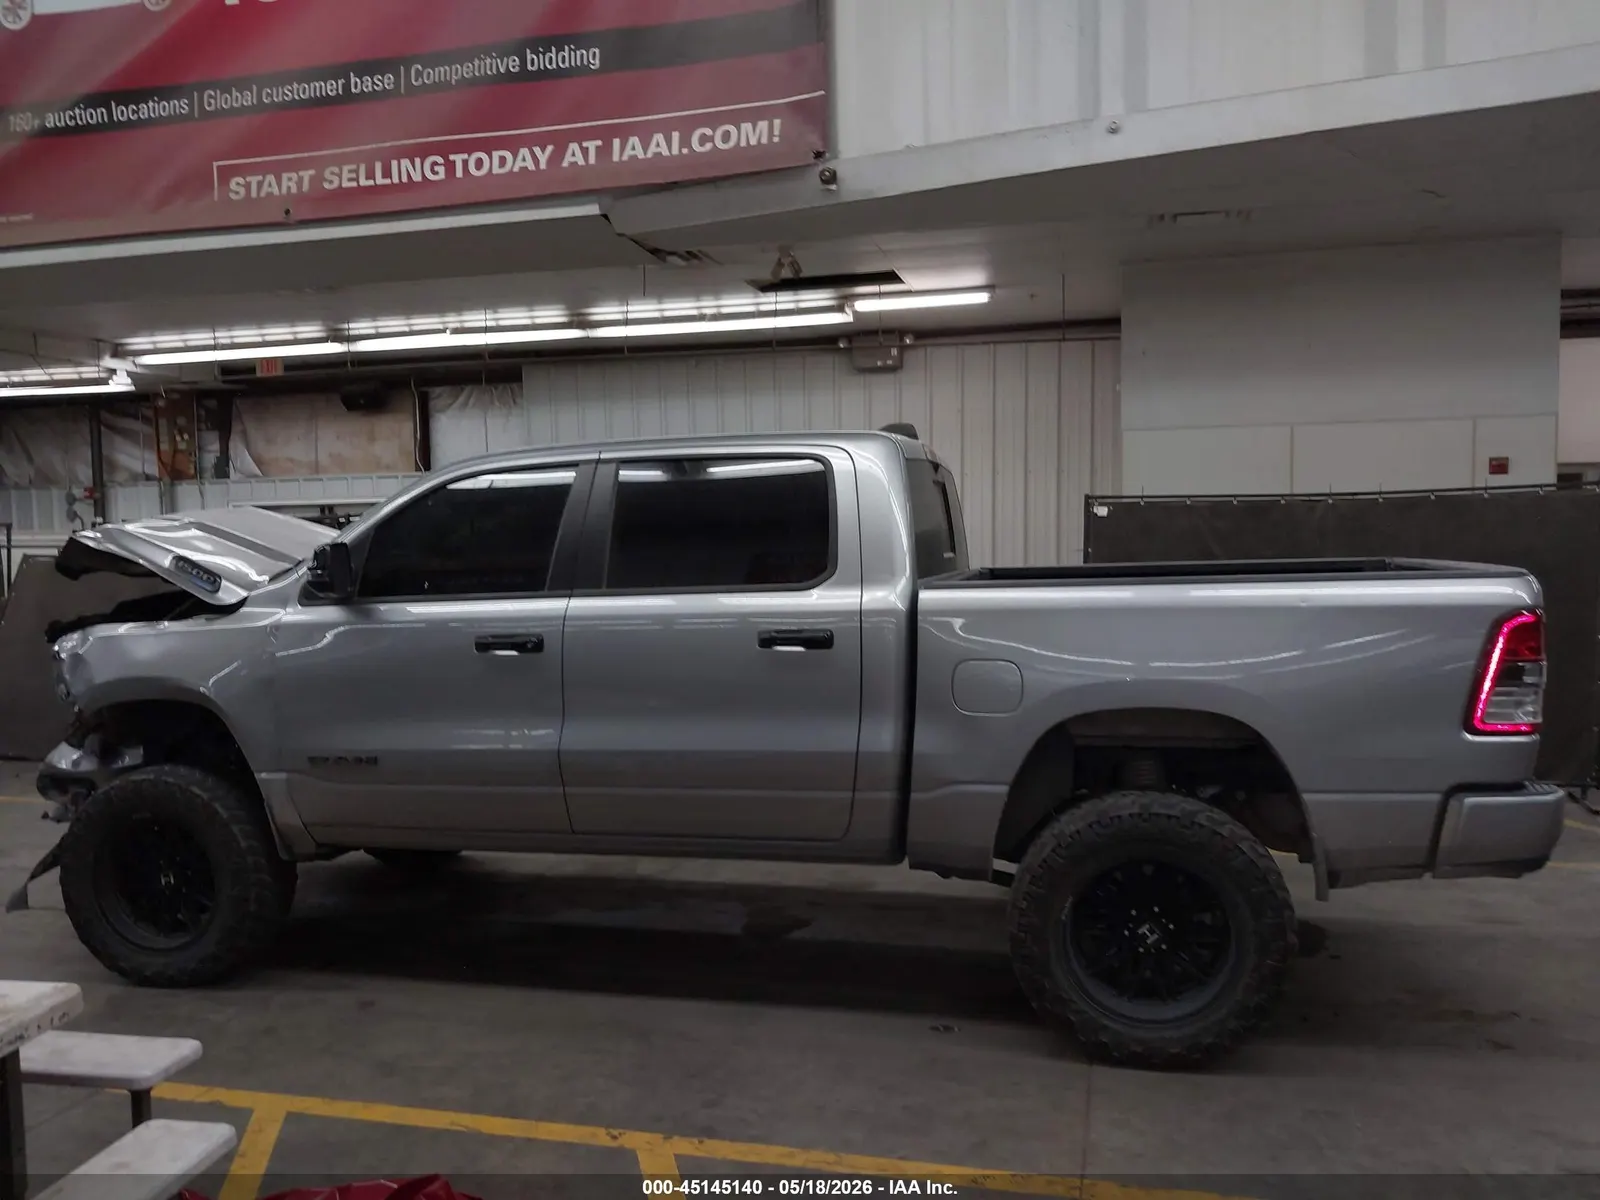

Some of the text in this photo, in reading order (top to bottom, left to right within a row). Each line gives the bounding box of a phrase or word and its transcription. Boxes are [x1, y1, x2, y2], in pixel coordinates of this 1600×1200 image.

[44, 103, 109, 129] auction
[111, 96, 189, 122] locations
[203, 85, 257, 112] Global
[262, 79, 345, 105] customer
[350, 67, 394, 94] base
[410, 50, 520, 86] Competitive
[526, 45, 600, 71] bidding
[228, 118, 782, 200] START SELLING TODAY AT IAAI.COM!
